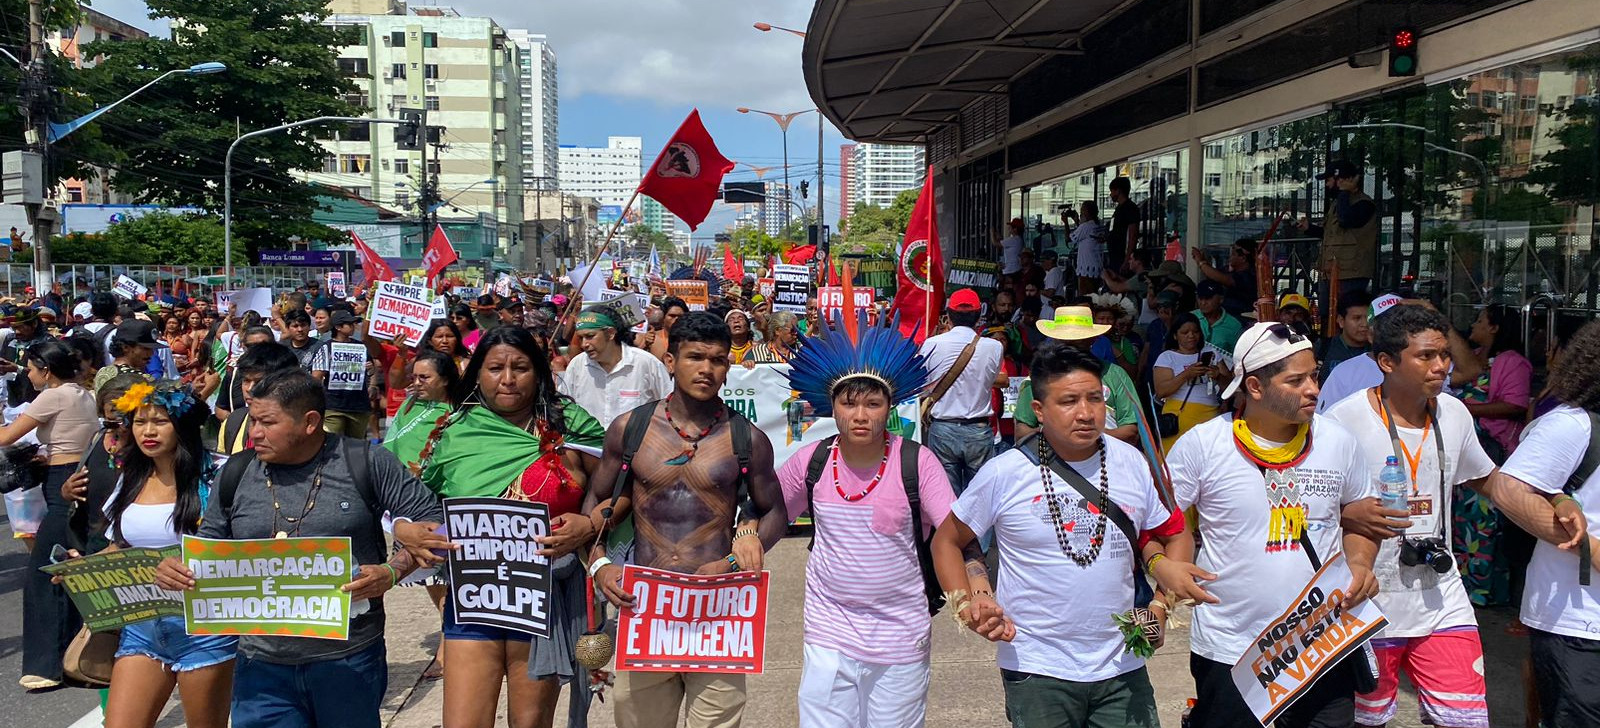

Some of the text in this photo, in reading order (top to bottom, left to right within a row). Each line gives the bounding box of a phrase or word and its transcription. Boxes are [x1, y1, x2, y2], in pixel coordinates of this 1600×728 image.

[384, 283, 421, 299] SEMPRE
[775, 291, 807, 304] JUSTIÇA
[821, 292, 829, 306] O
[831, 292, 870, 307] FURO
[333, 351, 363, 362] SEMPRE
[332, 372, 360, 382] AQUI
[723, 388, 755, 396] DOS
[449, 513, 546, 542] MARCO
[452, 539, 548, 565] TEMPORAL
[188, 553, 345, 579] DEMARCAÇÃO
[497, 562, 510, 580] É
[64, 573, 98, 593] FIM
[93, 568, 133, 587] DOS
[262, 577, 277, 595] É
[88, 588, 118, 610] NA
[192, 596, 342, 621] DEMOCRACIA
[457, 583, 546, 620] GOLPE
[632, 581, 757, 618] O FUTURO
[1257, 586, 1325, 653] NOSSO
[1583, 620, 1600, 634] Yo
[626, 613, 754, 657] É INDÍGENA
[1251, 588, 1345, 678] FUTURO
[1284, 612, 1367, 683] VENDA
